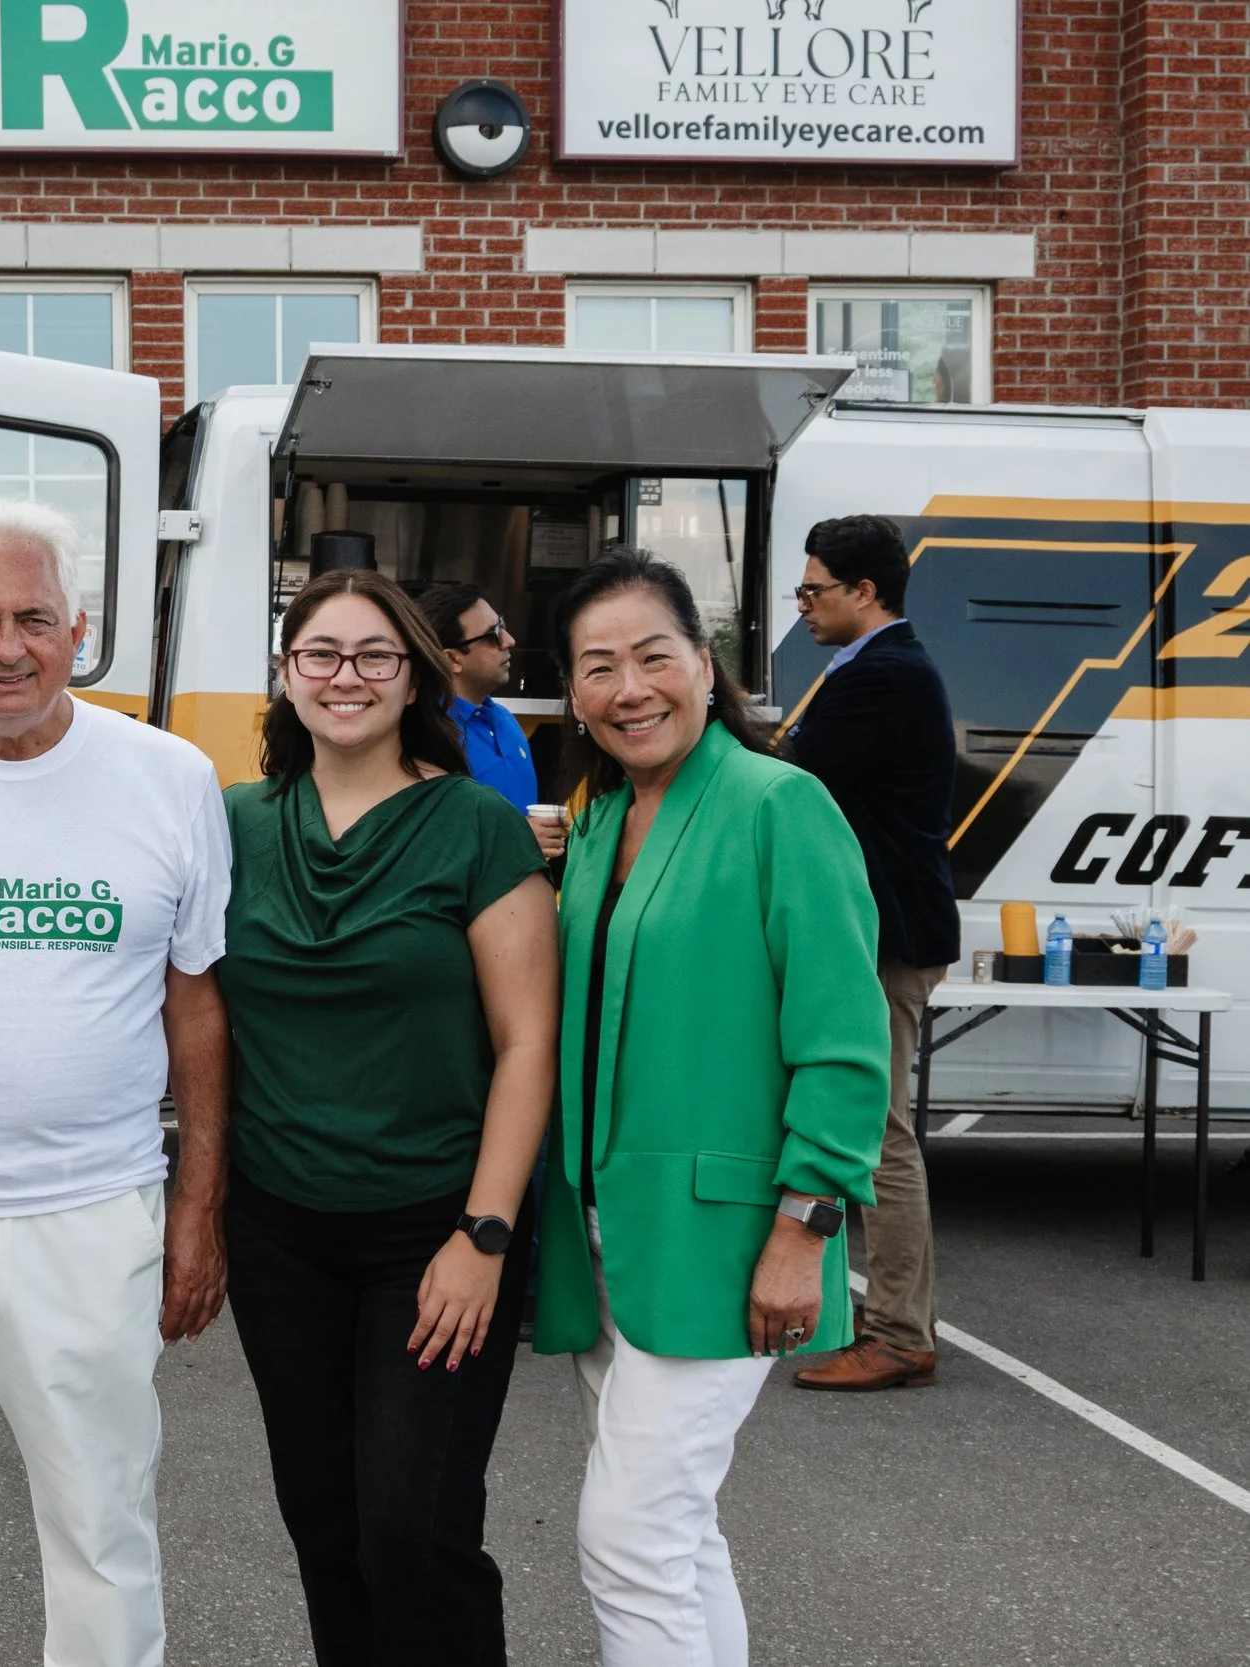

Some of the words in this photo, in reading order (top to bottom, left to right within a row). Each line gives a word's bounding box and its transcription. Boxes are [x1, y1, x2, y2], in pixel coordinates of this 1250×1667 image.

[141, 33, 259, 67] Mario.
[268, 35, 295, 67] G
[648, 26, 936, 80] VELLORE
[657, 82, 770, 103] FAMILY
[783, 83, 837, 104] EYE
[848, 84, 926, 106] CARE
[597, 114, 985, 148] vellorefamilyeyecare.com
[865, 364, 893, 377] less
[1050, 813, 1250, 889] COF
[91, 879, 120, 902] G.
[47, 942, 115, 953] RESPONSIVE.
